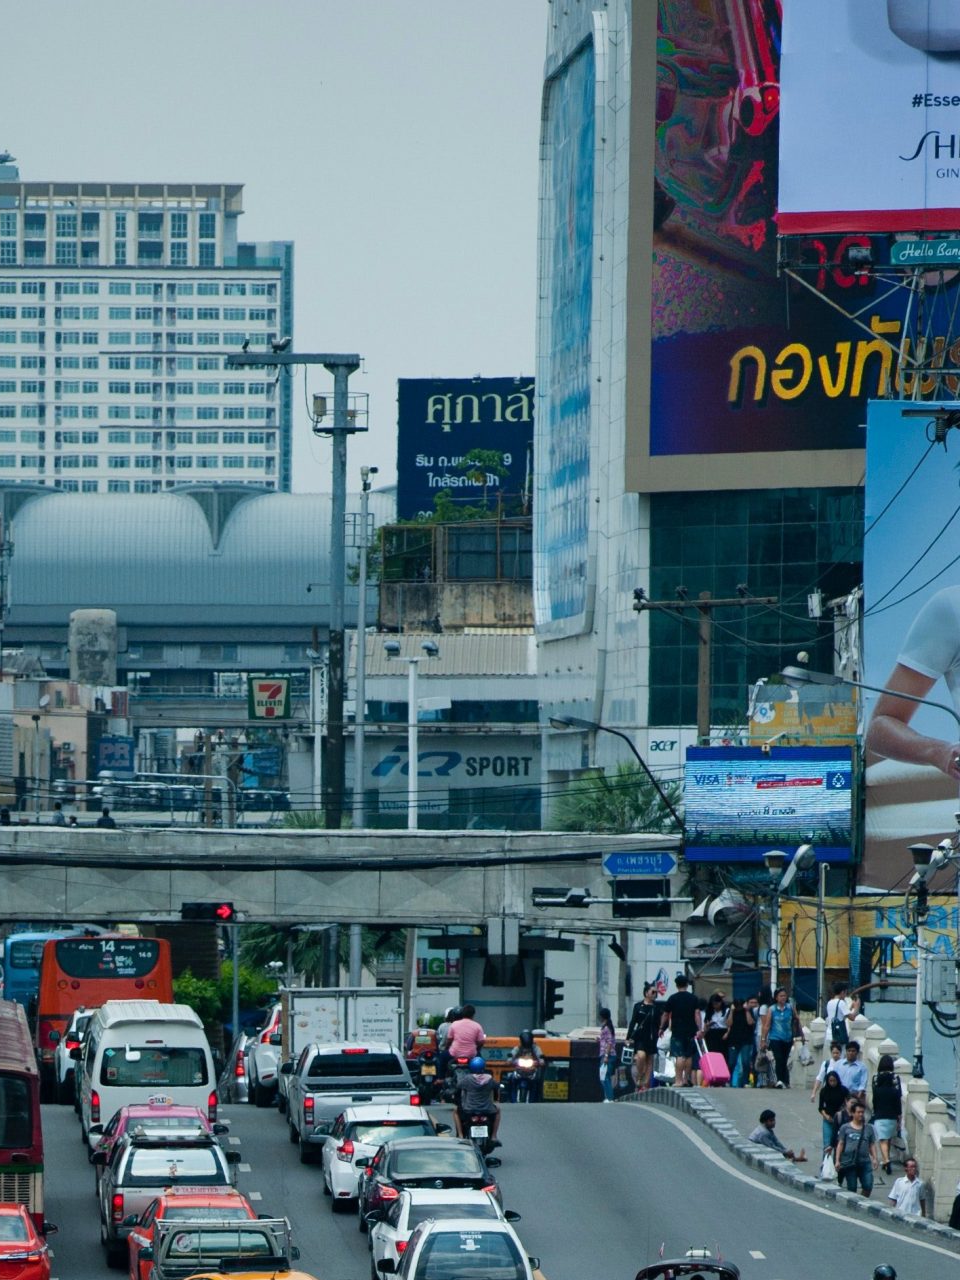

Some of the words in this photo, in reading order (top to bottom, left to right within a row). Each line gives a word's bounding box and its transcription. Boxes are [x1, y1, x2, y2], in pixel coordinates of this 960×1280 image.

[899, 243, 934, 259] Hello
[415, 453, 434, 467] ริม
[503, 453, 512, 465] 9
[256, 699, 283, 708] ELEVEN
[650, 739, 677, 751] acer
[465, 756, 533, 777] SPORT
[694, 774, 720, 785] VISA
[99, 940, 116, 953] 14
